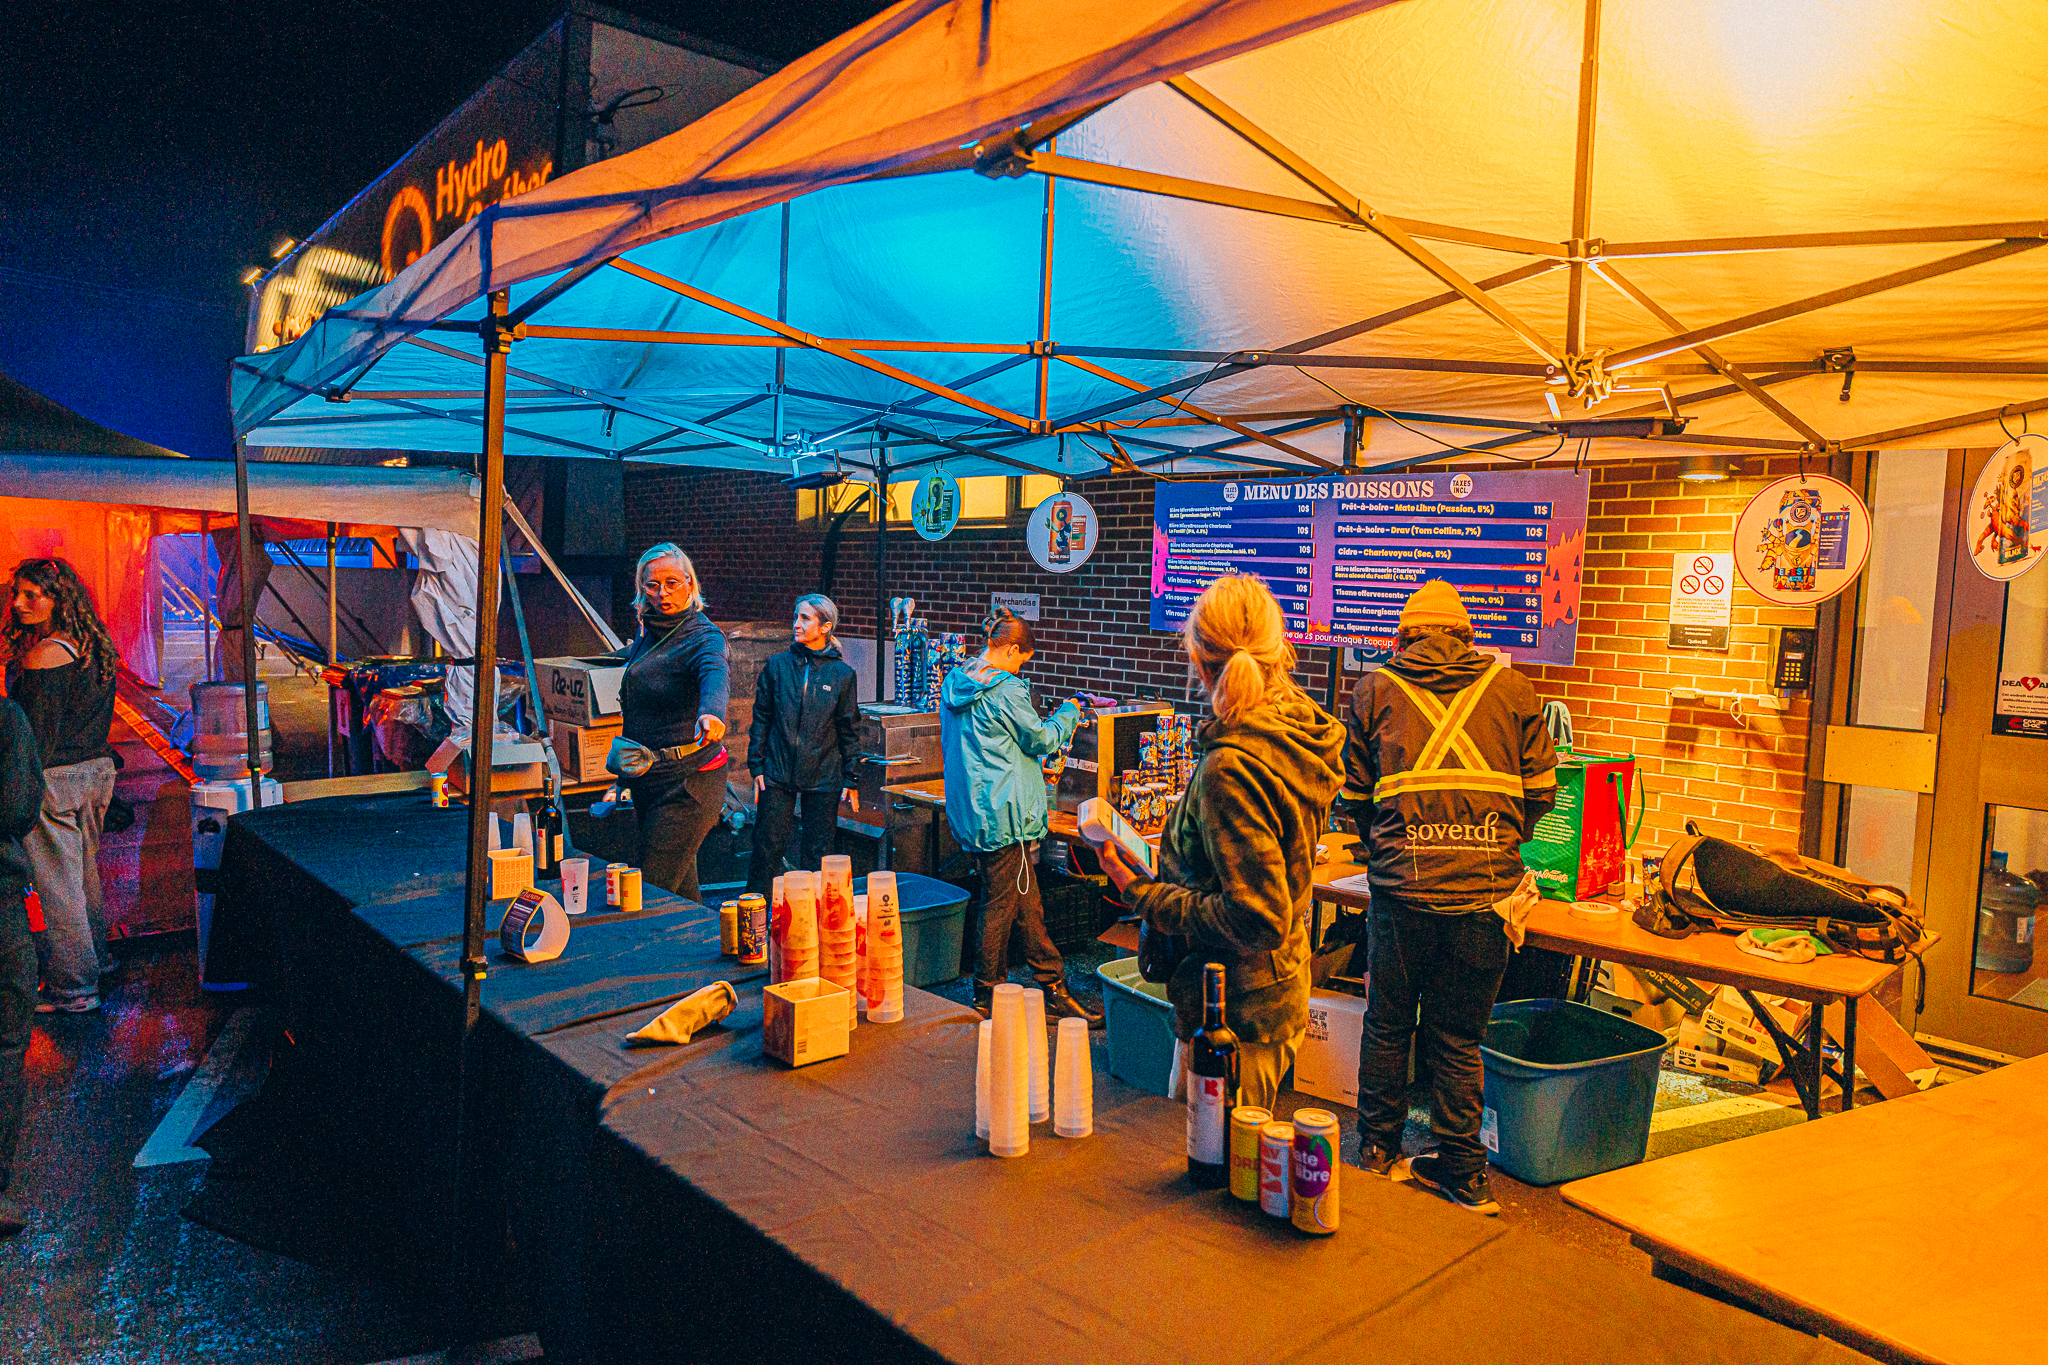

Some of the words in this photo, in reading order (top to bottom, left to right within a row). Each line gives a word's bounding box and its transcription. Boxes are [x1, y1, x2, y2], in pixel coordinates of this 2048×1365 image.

[436, 139, 508, 221] Hydro
[1243, 483, 1291, 501] MENU
[1295, 483, 1329, 500] DES
[1332, 480, 1435, 499] BOISSONS
[1298, 504, 1310, 513] 10$
[1341, 502, 1389, 511] Prêt-à-boire
[1395, 504, 1415, 512] Mate
[1416, 503, 1436, 512] Libre
[1437, 503, 1476, 515] (Passion,
[1477, 504, 1494, 515] 5%)
[1533, 505, 1548, 515] 11$
[1297, 526, 1309, 535] 10$
[1337, 525, 1385, 533] Prêt-à-boire
[1391, 526, 1410, 534] Drav
[1411, 525, 1432, 536] (Tom
[1433, 526, 1464, 536] Collins,
[1465, 526, 1481, 537] 7%)
[1526, 527, 1543, 537] 10$
[1299, 545, 1311, 554] 10$
[1338, 548, 1358, 556] Cidre
[1363, 549, 1413, 559] Charlevoyou
[1414, 549, 1434, 559] (Sec,
[1435, 549, 1451, 560] 5%)
[1526, 552, 1543, 562] 10$
[1296, 566, 1308, 575] 10$
[1525, 573, 1538, 584] 9$
[1296, 584, 1308, 592] 10$
[1335, 588, 1357, 596] Tisane
[1358, 589, 1404, 599] effervescente
[994, 597, 1036, 606] Merchandise
[1174, 595, 1189, 603] rouge
[1488, 596, 1504, 606] 0%)
[1525, 597, 1538, 607] 9$
[1292, 602, 1305, 611] 10$
[1336, 606, 1361, 614] Boisson
[1478, 613, 1507, 621] variées
[1526, 615, 1538, 625] 6$
[1293, 620, 1305, 629] 10$
[1333, 623, 1346, 631] Jus,
[1347, 624, 1370, 633] liqueur
[1305, 633, 1313, 641] 2$
[1315, 634, 1332, 643] pour
[1333, 634, 1362, 645] chaque
[1364, 637, 1393, 648] Ecocup
[1521, 633, 1533, 643] 5$
[1405, 811, 1499, 843] soverdi
[1708, 1014, 1725, 1025] Drav
[1679, 1049, 1696, 1058] Drav
